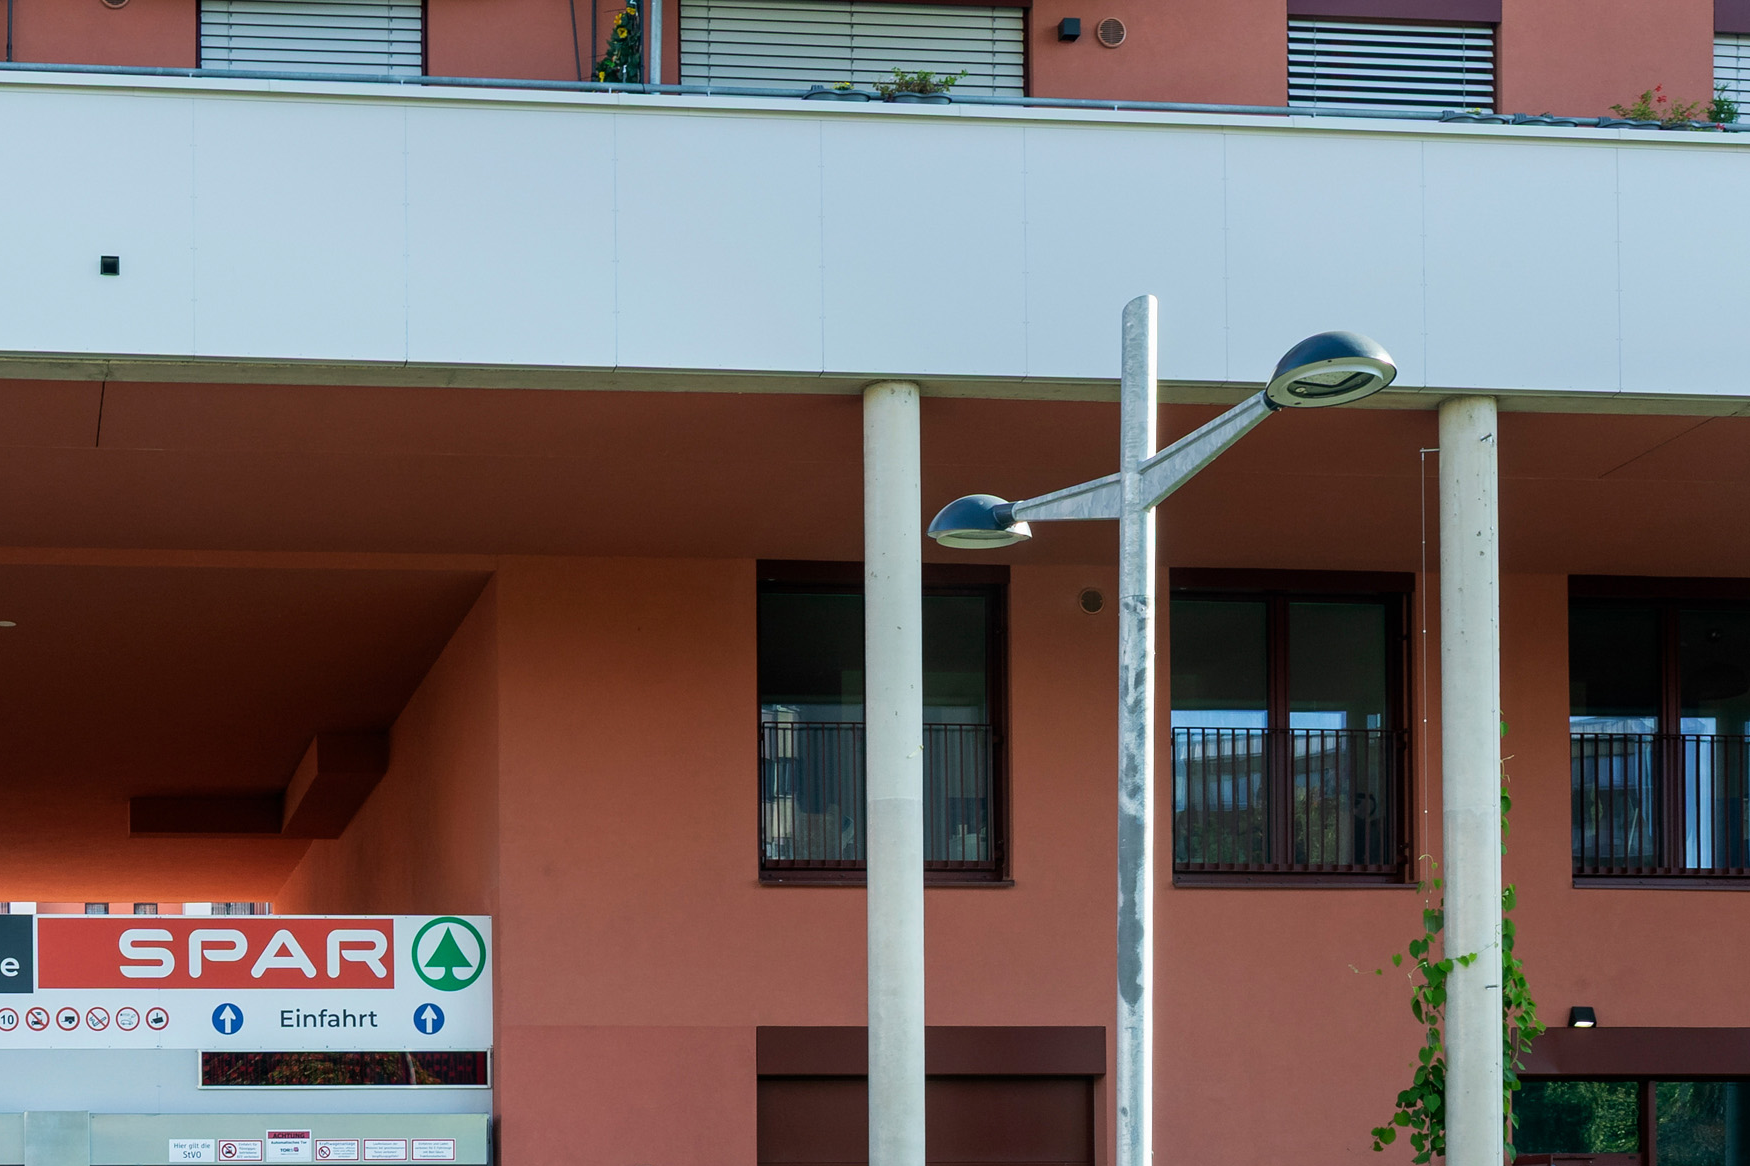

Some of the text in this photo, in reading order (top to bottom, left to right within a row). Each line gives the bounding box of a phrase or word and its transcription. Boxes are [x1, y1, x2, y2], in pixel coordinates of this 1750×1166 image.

[118, 928, 388, 979] SPAR
[0, 1014, 15, 1025] 10
[280, 1008, 378, 1028] Einfahrt
[188, 1142, 199, 1151] gilt
[182, 1150, 202, 1159] StVO
